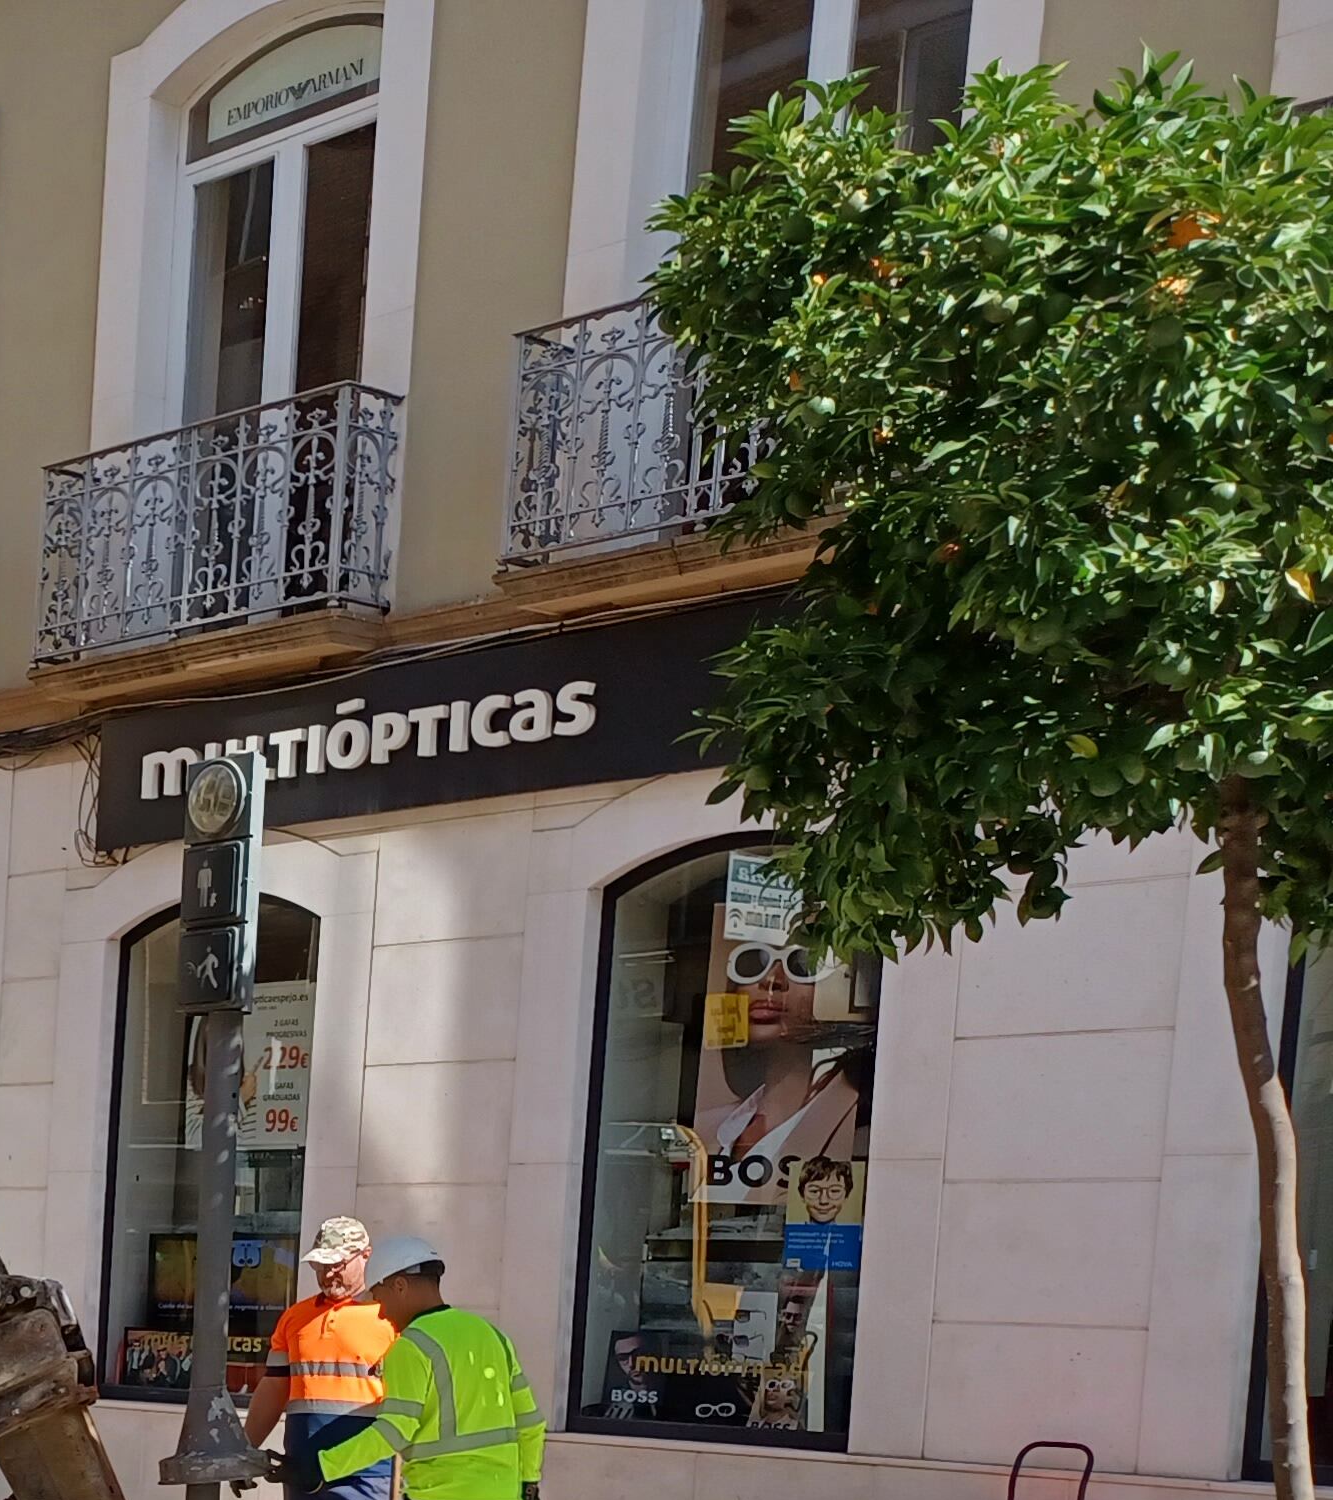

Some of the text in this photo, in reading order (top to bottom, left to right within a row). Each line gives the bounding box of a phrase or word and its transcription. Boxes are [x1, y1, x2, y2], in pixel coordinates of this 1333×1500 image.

[227, 58, 364, 126] EMPORIO ARMANI
[265, 1108, 299, 1133] 99€
[611, 1389, 659, 1404] BOSS
